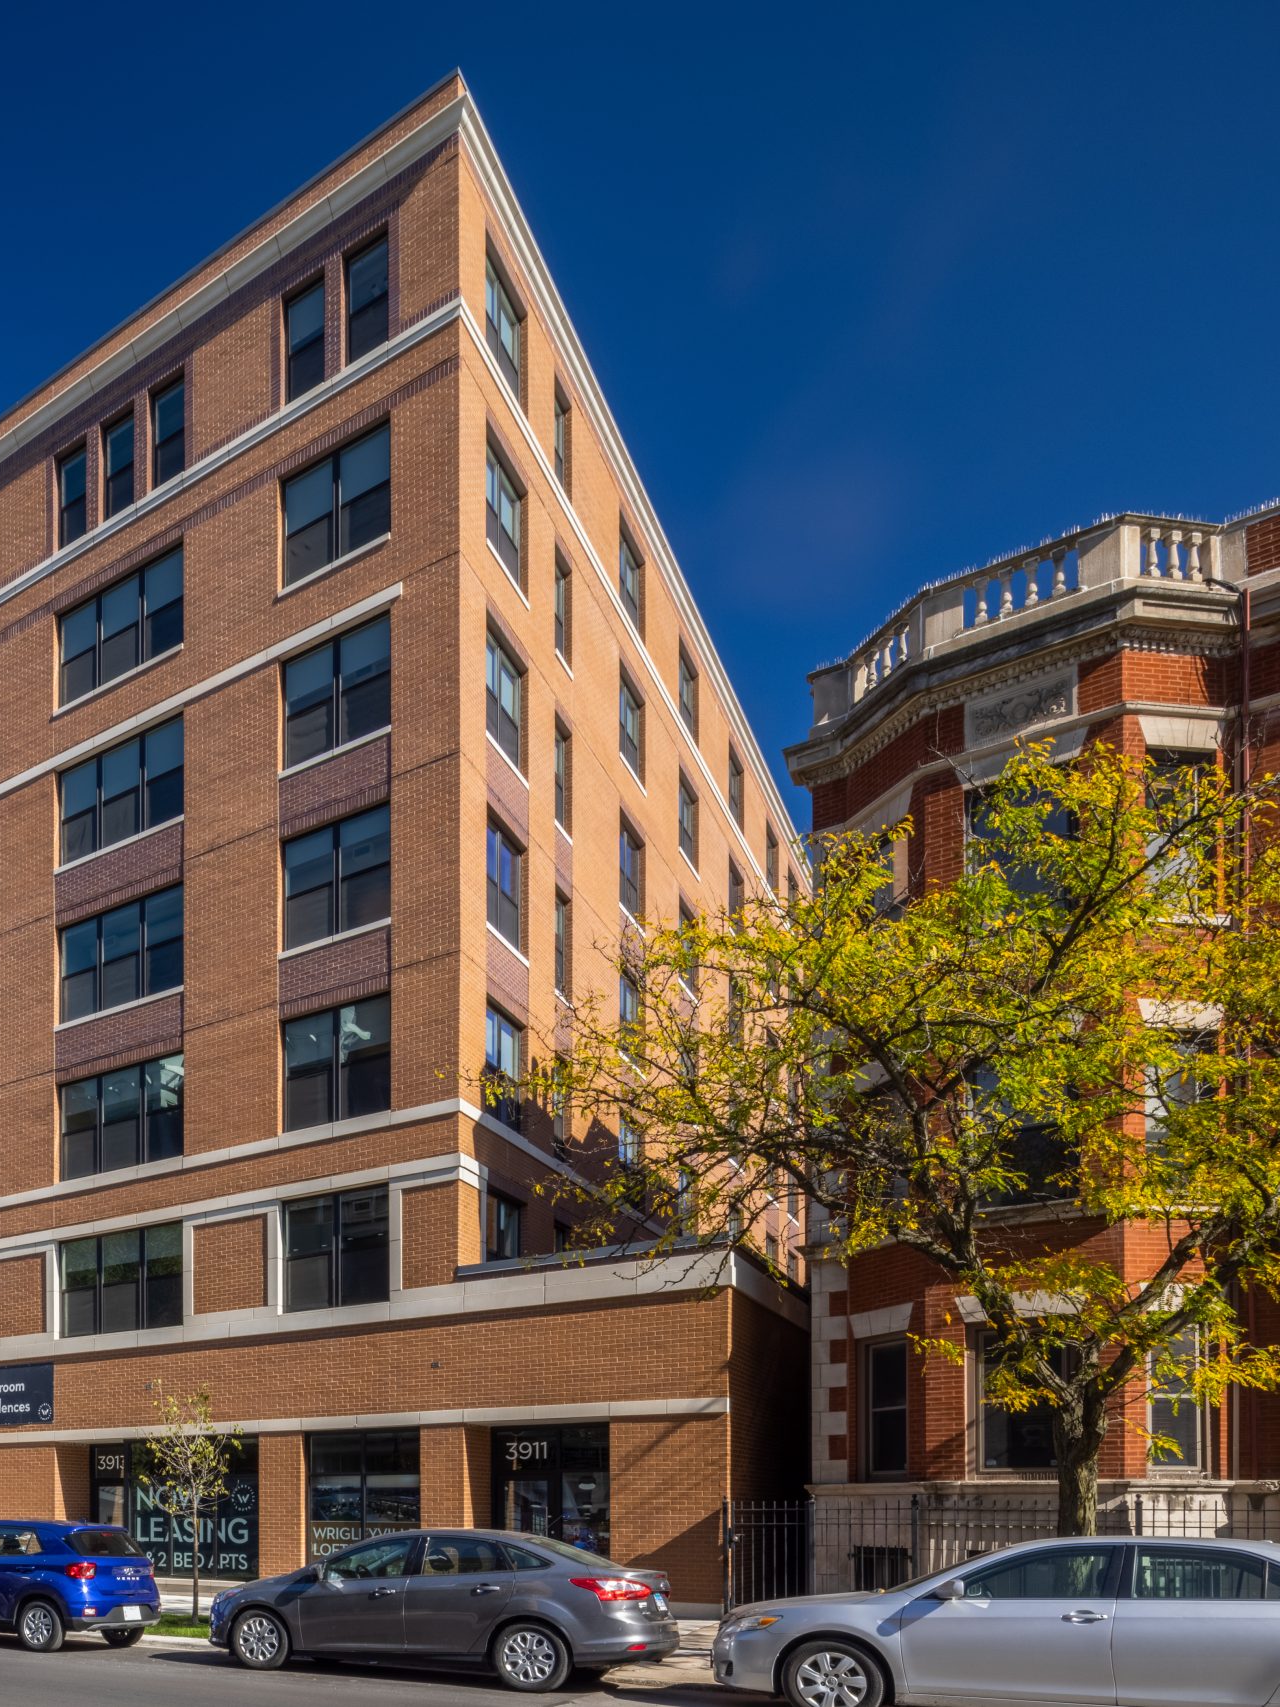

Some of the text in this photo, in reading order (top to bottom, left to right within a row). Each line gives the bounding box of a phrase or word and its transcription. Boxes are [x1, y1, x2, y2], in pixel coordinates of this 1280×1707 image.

[504, 1441, 548, 1460] 3911
[136, 1516, 249, 1544] LEASING
[157, 1551, 167, 1567] 2
